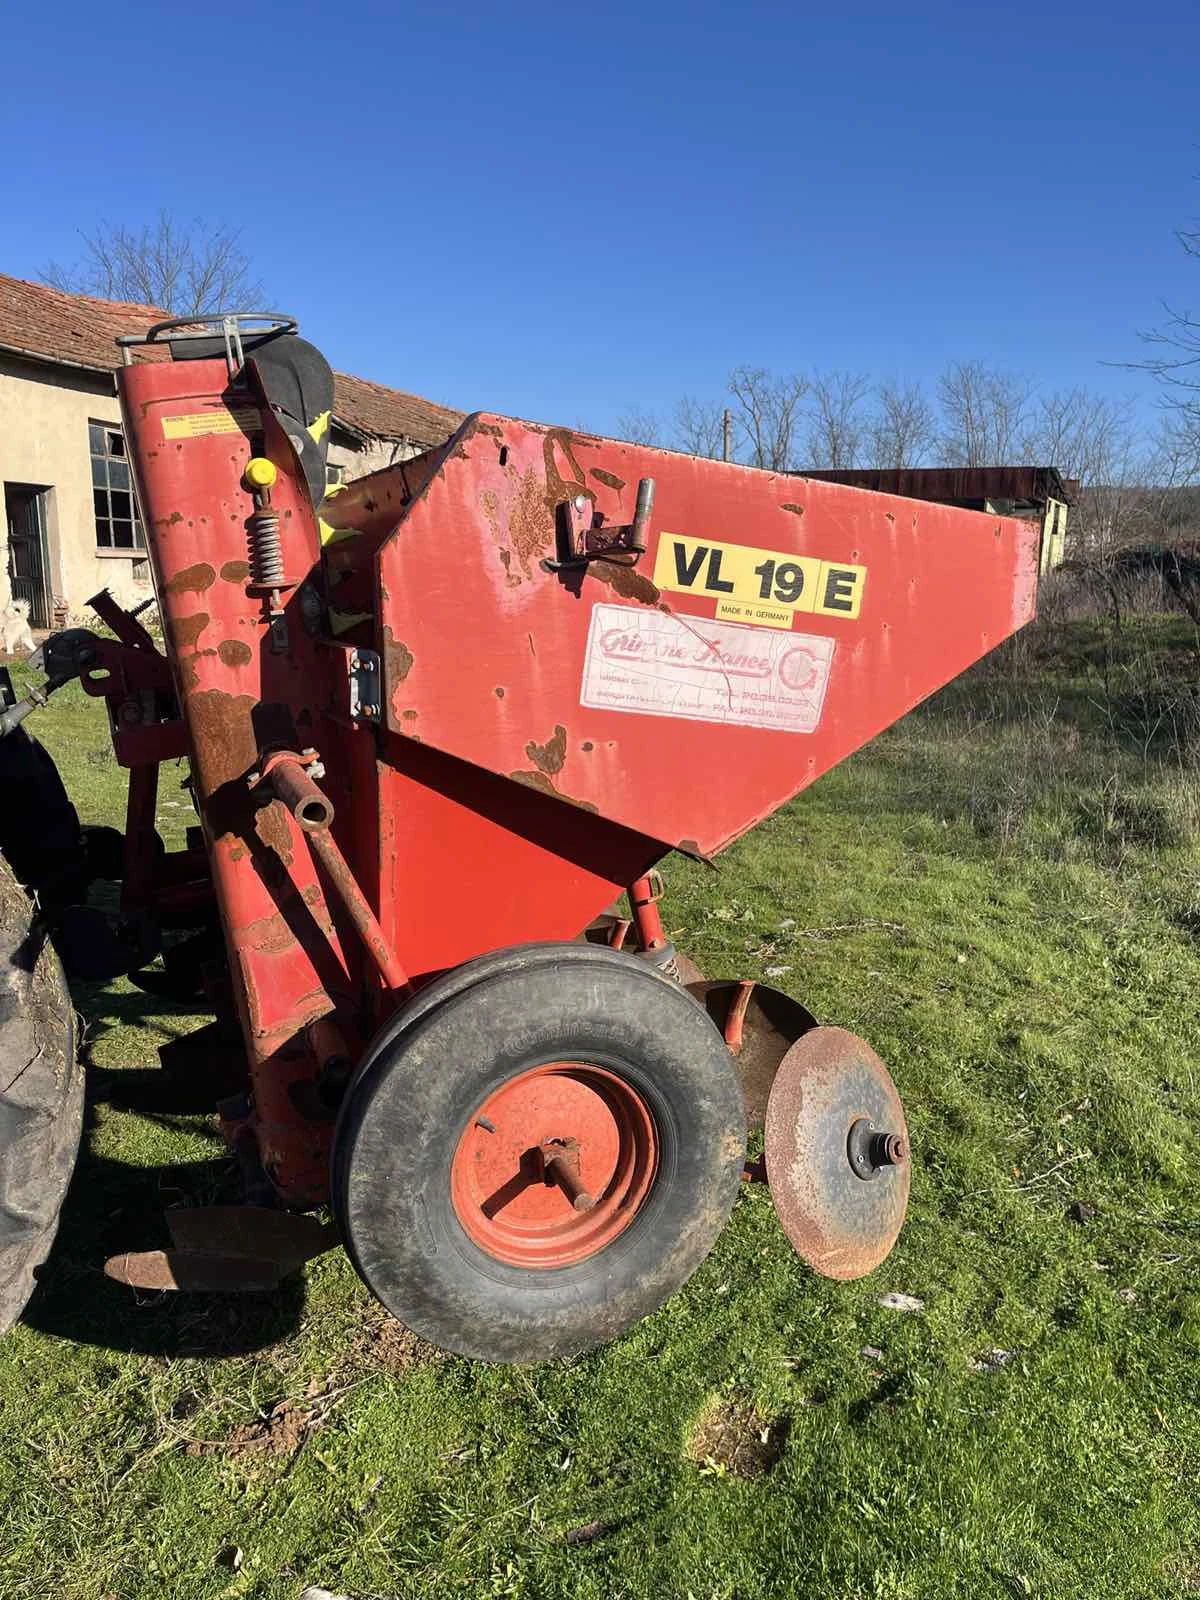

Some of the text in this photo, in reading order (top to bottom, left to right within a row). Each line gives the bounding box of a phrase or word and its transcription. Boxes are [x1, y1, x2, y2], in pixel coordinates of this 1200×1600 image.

[672, 541, 858, 612] VL 19 E
[720, 605, 790, 623] MADE IN GERMANY
